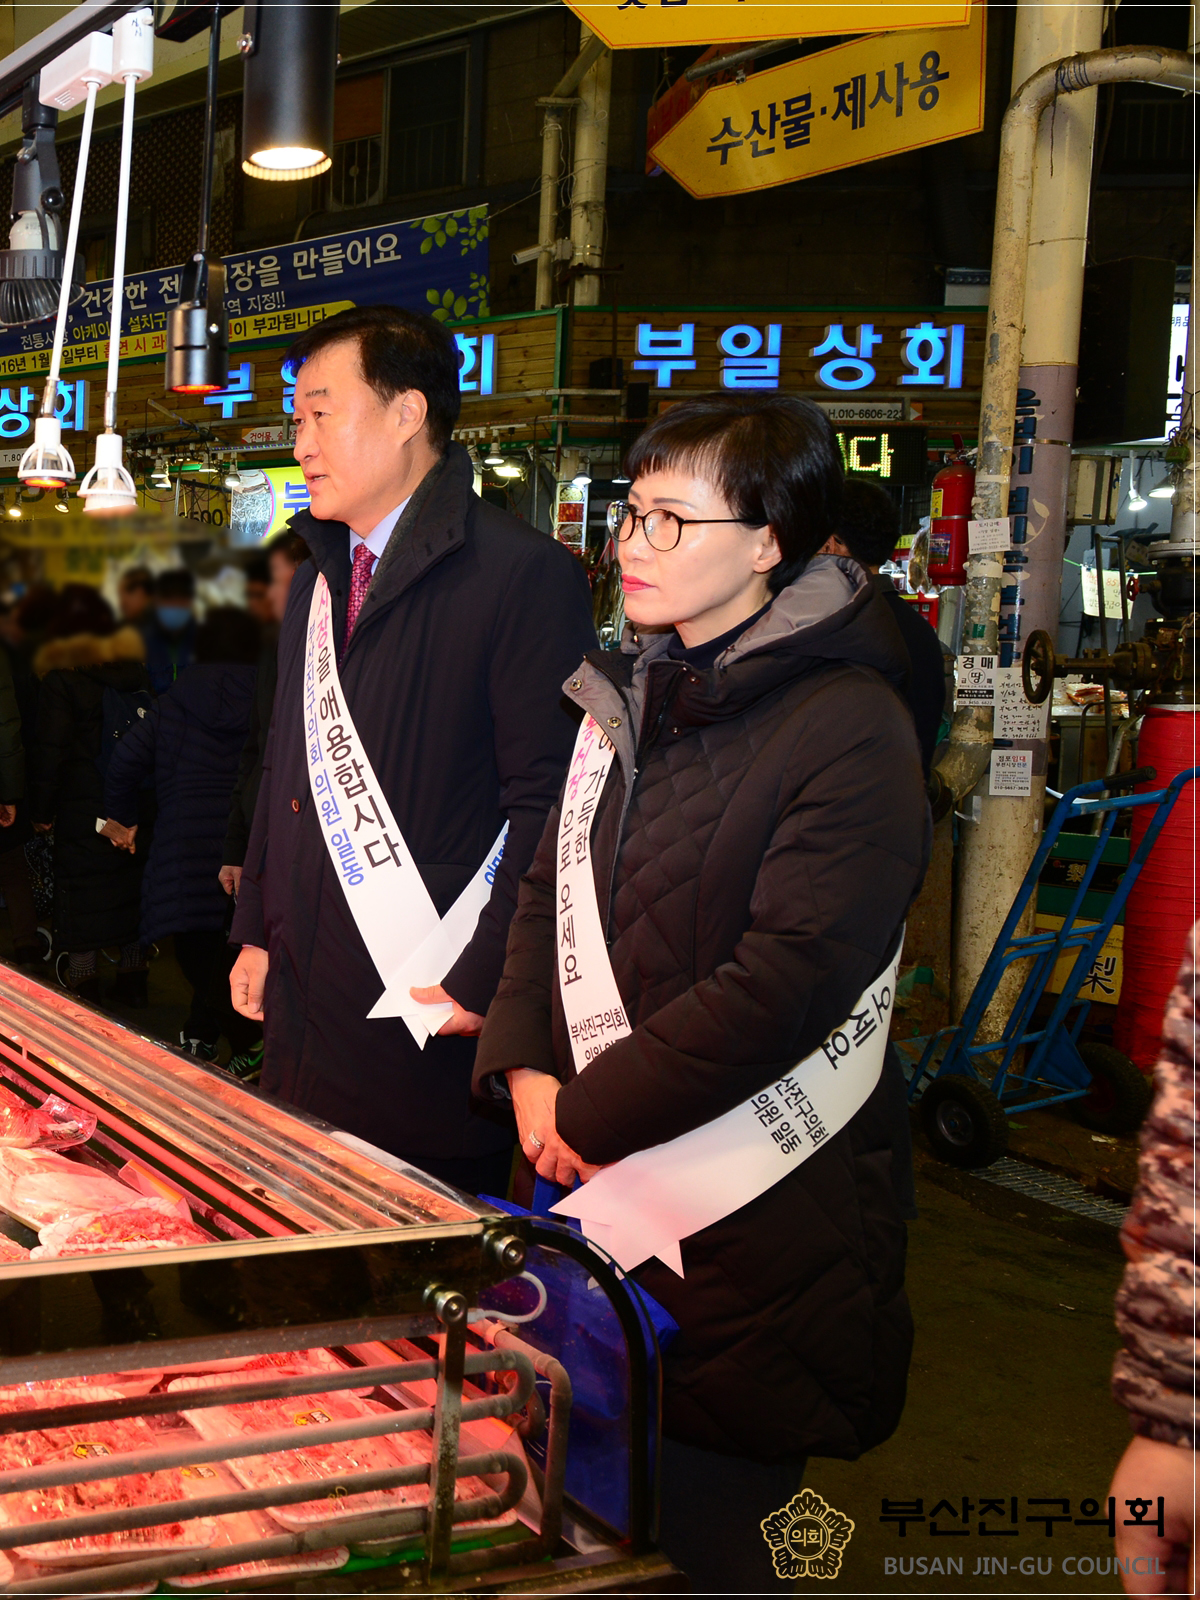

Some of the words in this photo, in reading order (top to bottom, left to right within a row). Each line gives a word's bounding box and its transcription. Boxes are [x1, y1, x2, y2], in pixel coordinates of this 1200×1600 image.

[293, 232, 402, 281] 만들어요
[73, 319, 124, 341] 아케이
[247, 290, 286, 313] 지정!!
[631, 322, 966, 391] 부일상회
[318, 685, 402, 870] 애용합시다
[312, 771, 343, 827] 의원
[329, 829, 365, 888] 일동
[575, 769, 606, 865] 가득한
[559, 883, 583, 987] 오세요
[570, 1006, 629, 1044] 부산진구의회
[821, 985, 891, 1070] 오세요
[750, 1092, 784, 1128] 의원
[770, 1121, 802, 1155] 일동
[774, 1076, 830, 1148] 산진구의회
